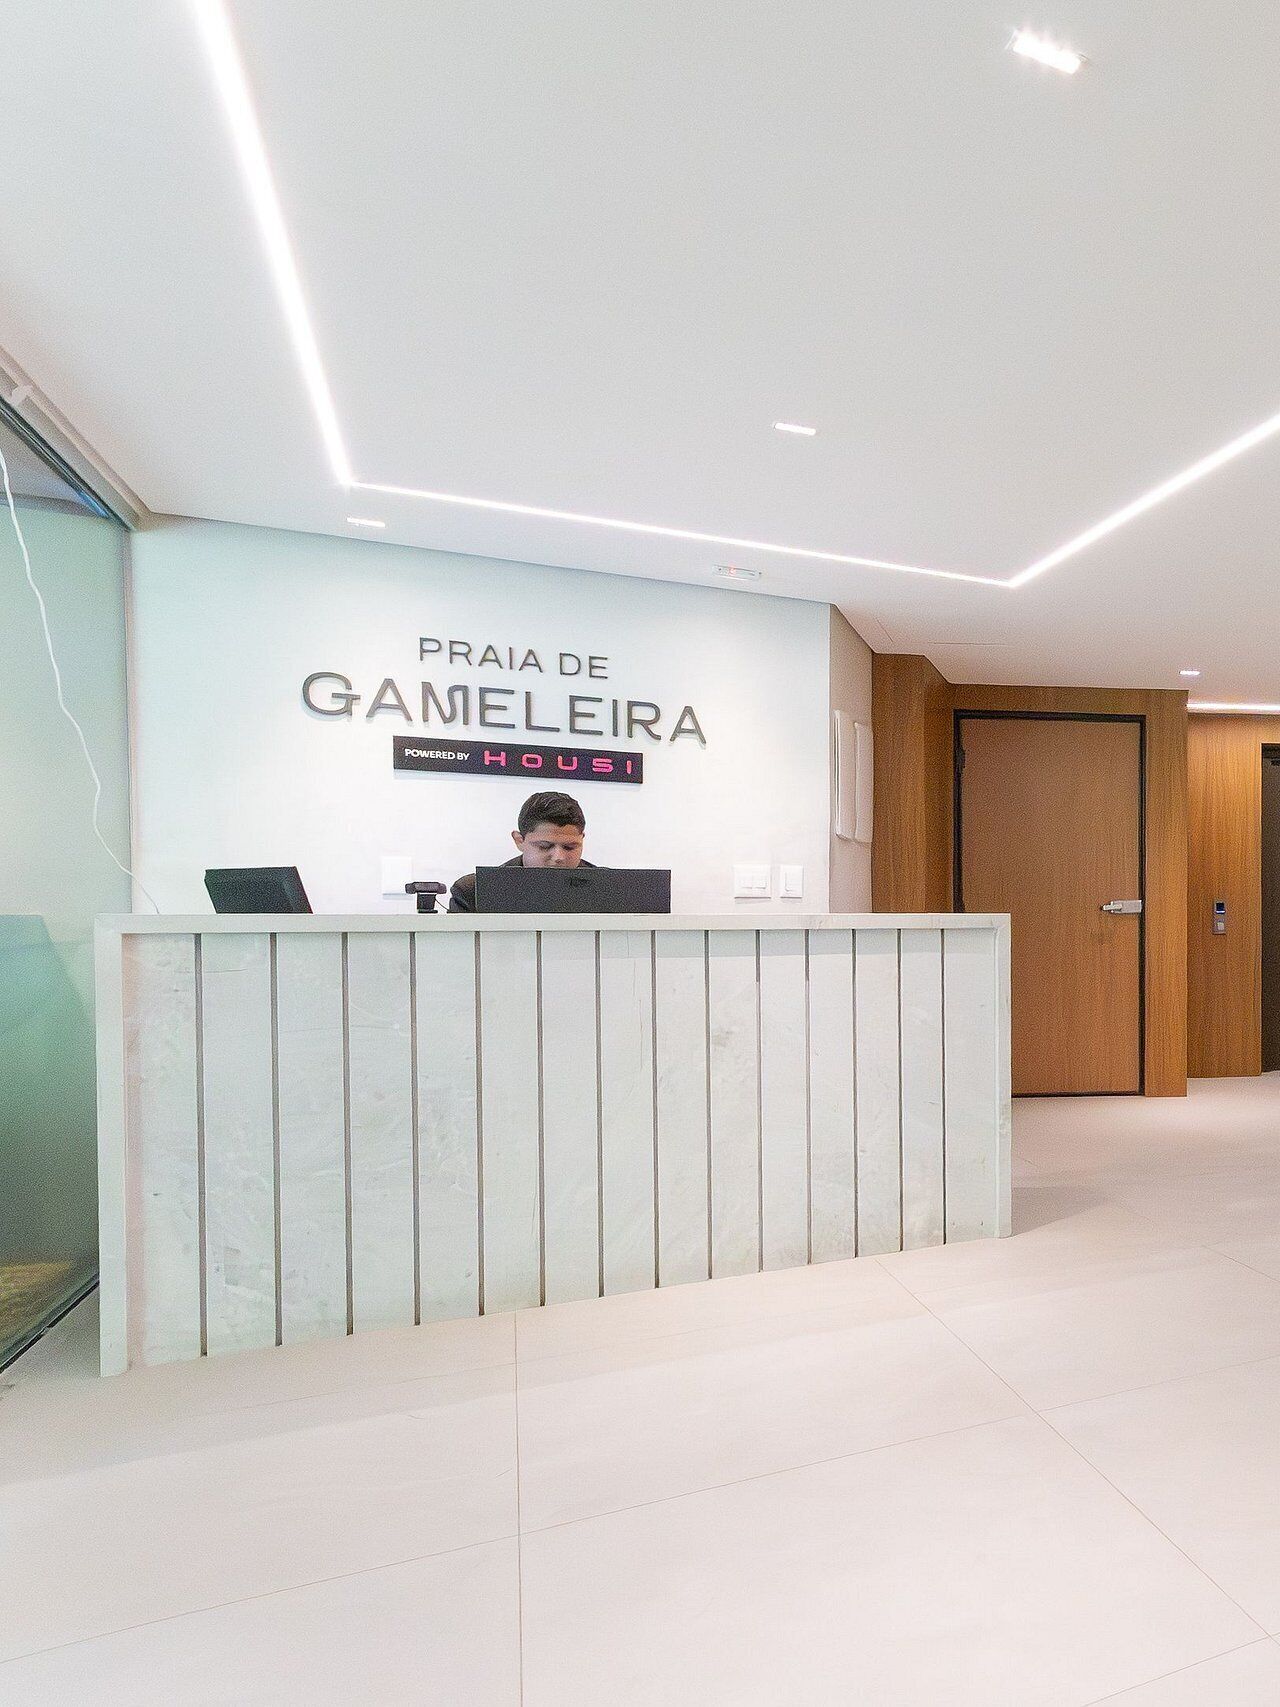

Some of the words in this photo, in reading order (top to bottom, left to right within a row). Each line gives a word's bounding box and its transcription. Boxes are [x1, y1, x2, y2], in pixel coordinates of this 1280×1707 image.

[420, 637, 543, 673] PRAIA
[559, 652, 608, 679] DE
[302, 671, 706, 745] GAMELEIRA
[404, 748, 456, 760] POWERED
[456, 752, 470, 761] BY
[484, 750, 632, 775] HOUSI
